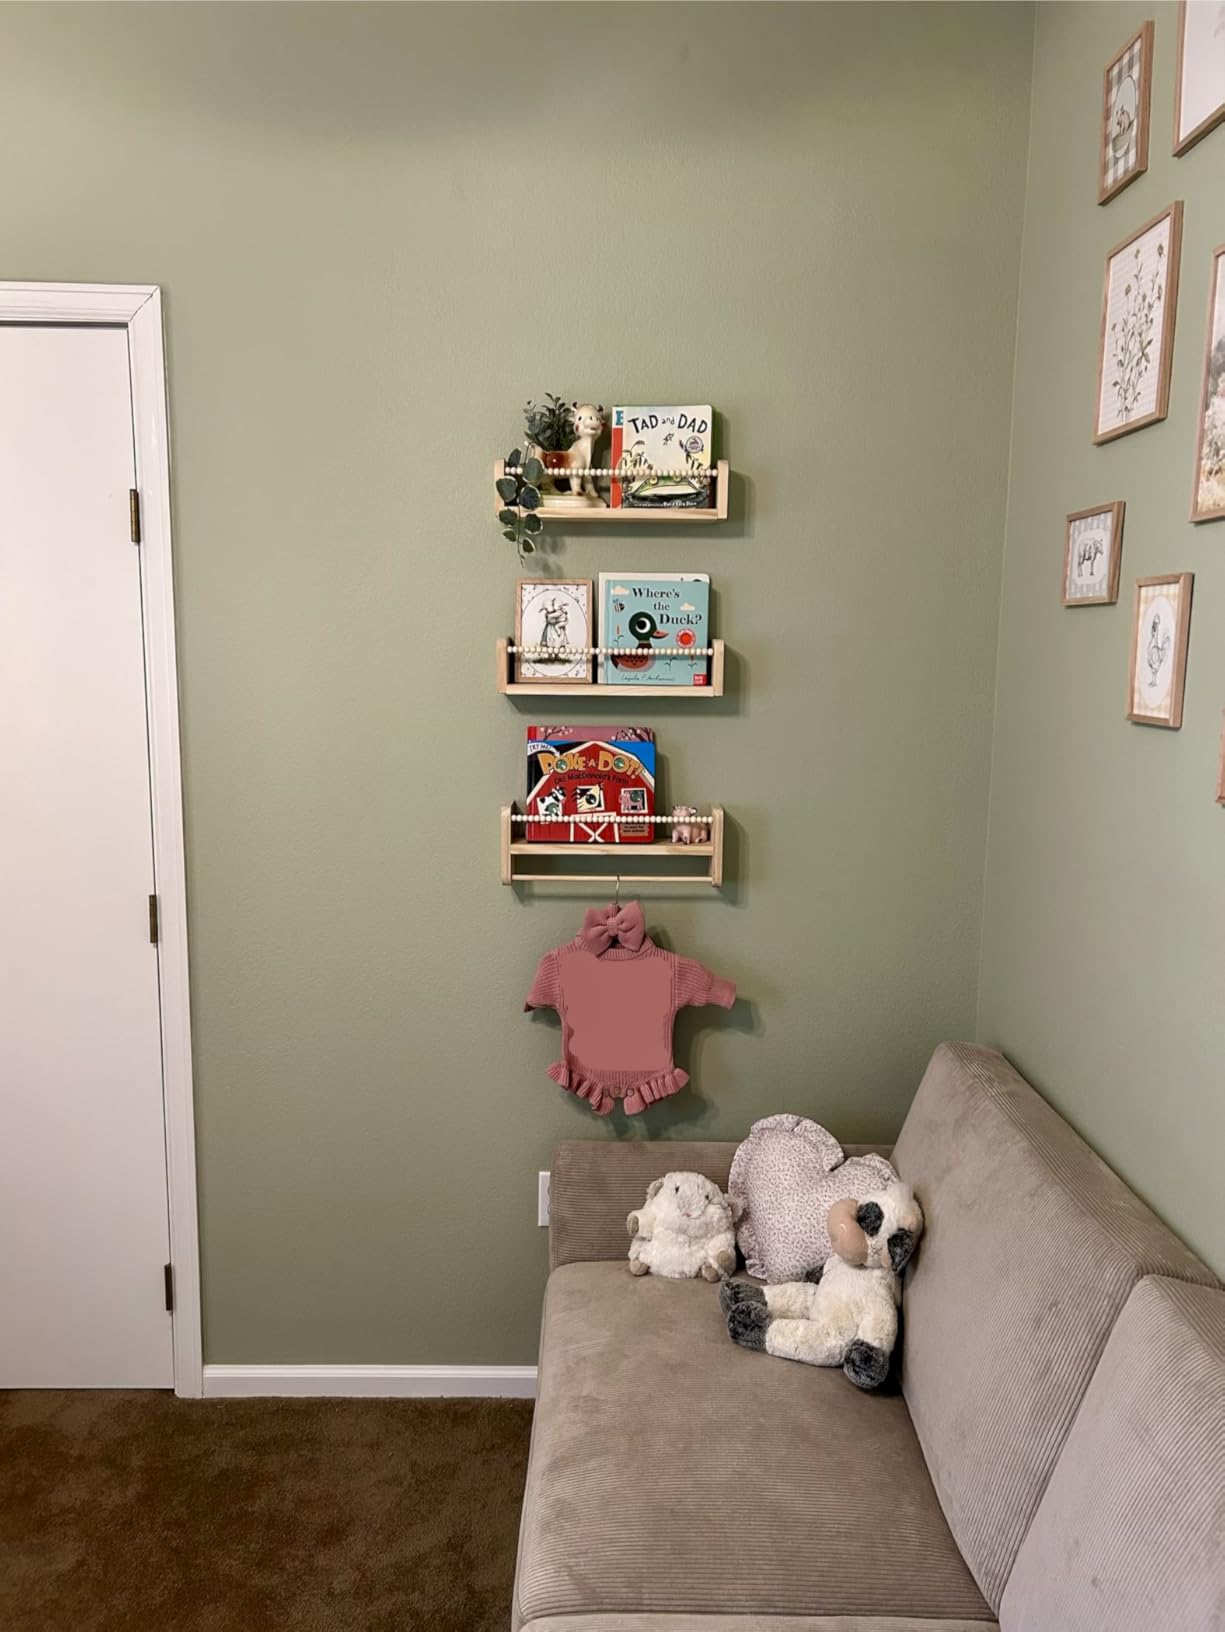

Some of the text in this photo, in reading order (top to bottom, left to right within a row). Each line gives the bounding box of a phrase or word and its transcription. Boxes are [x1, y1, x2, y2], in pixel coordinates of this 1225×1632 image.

[628, 413, 708, 434] TAD and DAD
[632, 587, 680, 598] Where's
[653, 601, 670, 611] the
[660, 613, 702, 625] Duck?
